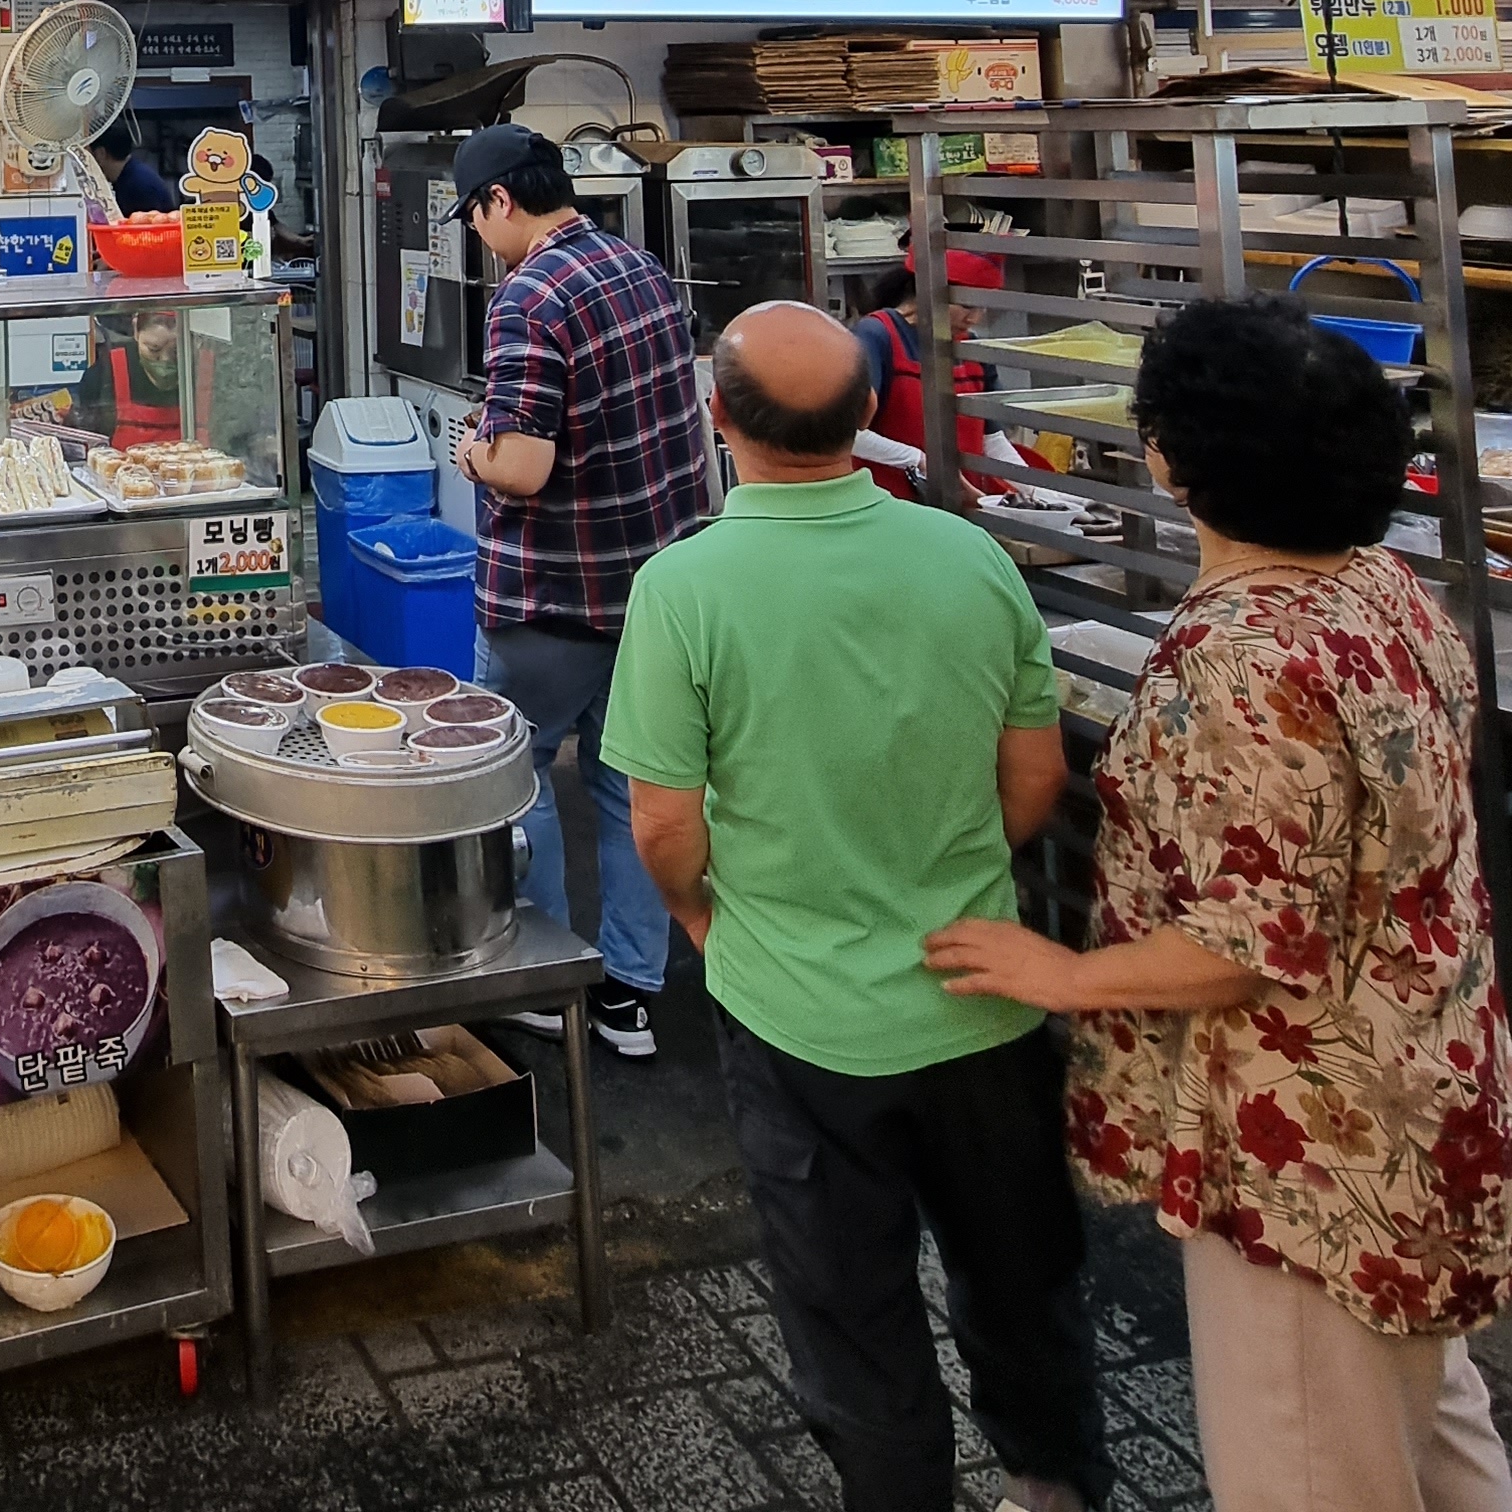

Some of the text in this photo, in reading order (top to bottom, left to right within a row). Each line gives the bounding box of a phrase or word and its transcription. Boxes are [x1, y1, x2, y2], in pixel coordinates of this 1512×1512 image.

[1415, 26, 1436, 41] 1개
[1417, 48, 1438, 63] 3개
[203, 517, 274, 545] 모닝빵
[18, 1037, 127, 1091] 단팥죽
